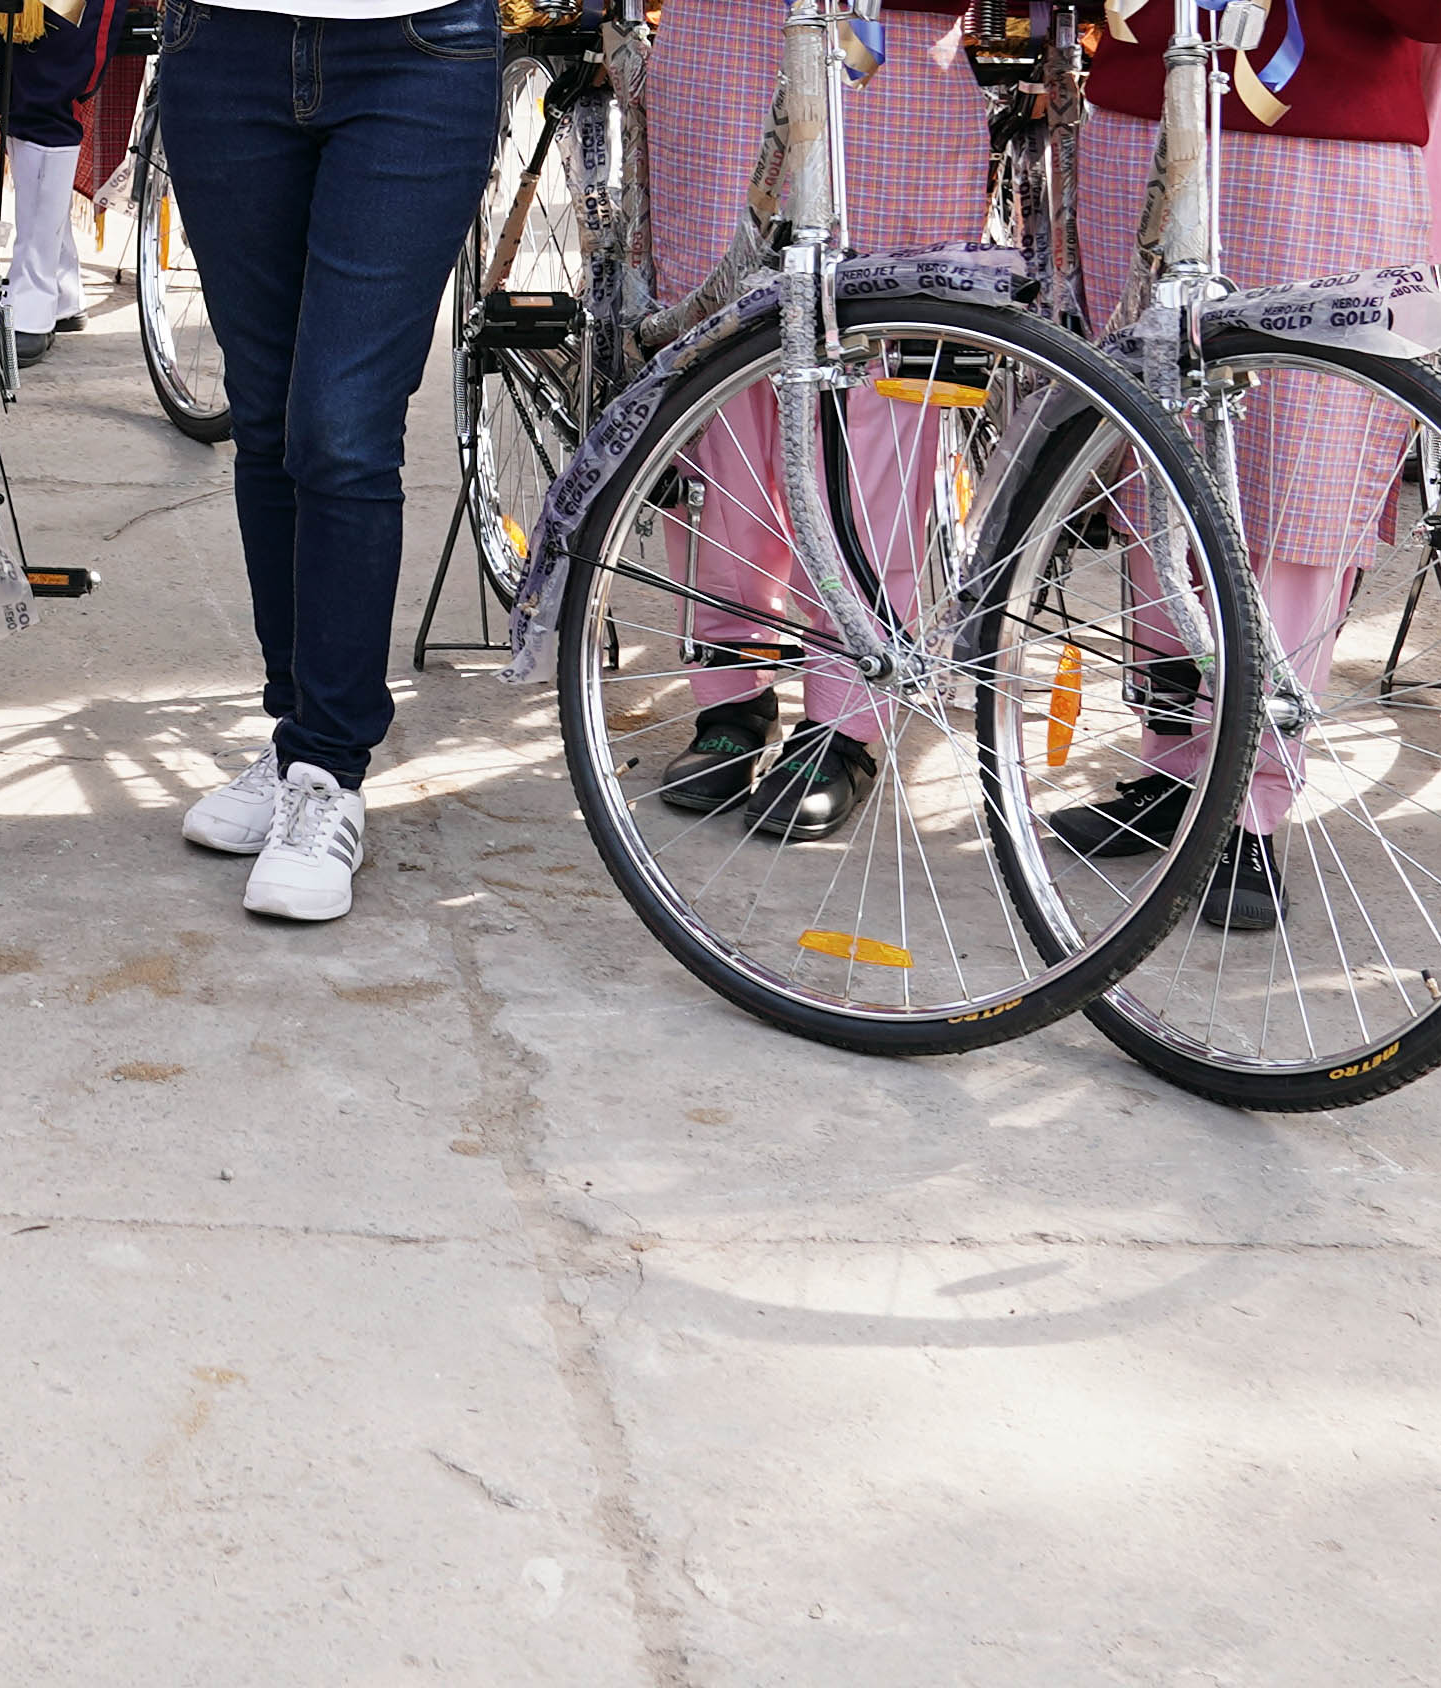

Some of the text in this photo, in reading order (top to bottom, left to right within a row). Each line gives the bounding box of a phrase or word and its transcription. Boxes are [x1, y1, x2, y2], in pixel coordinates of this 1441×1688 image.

[844, 278, 900, 297] GOLD
[918, 275, 974, 292] GOLD
[1260, 315, 1312, 331] GOLD
[1330, 310, 1381, 327] GOLD
[609, 403, 651, 457] GOLD
[1327, 1040, 1401, 1081] METRO
